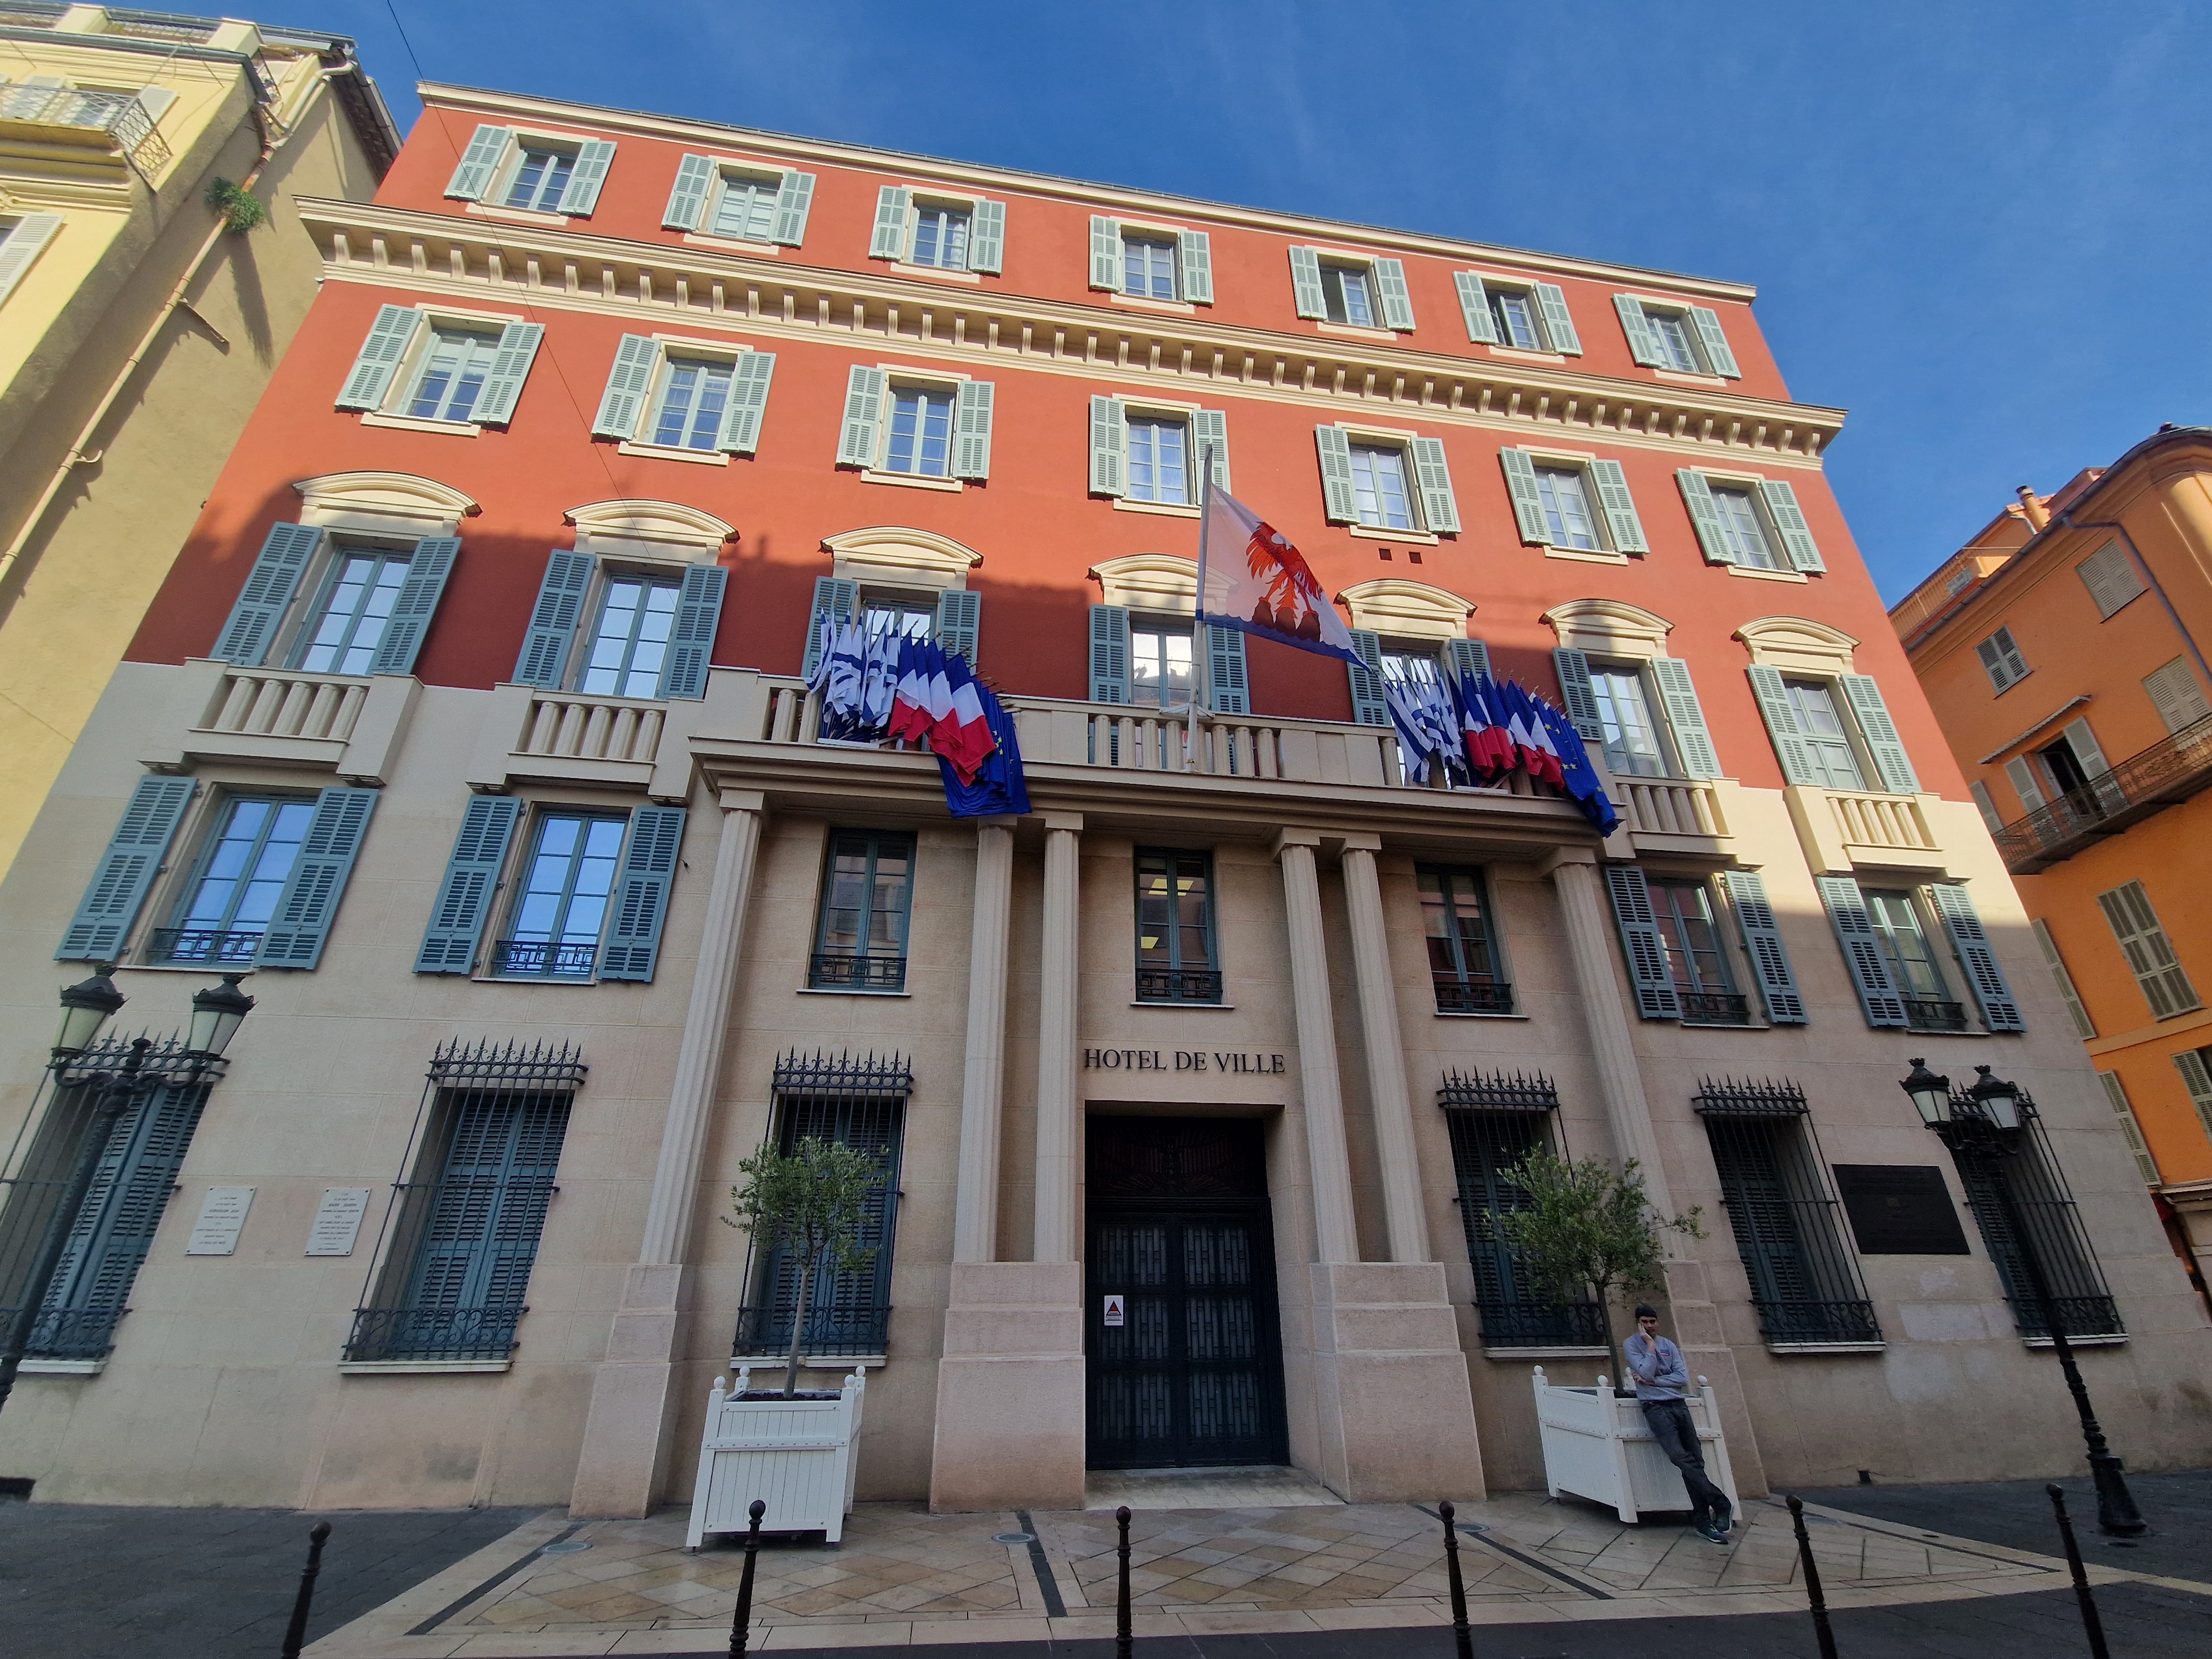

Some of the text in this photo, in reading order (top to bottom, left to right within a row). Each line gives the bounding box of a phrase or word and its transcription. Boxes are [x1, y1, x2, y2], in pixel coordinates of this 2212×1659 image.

[1083, 1048, 1286, 1073] HOTEL DE VILLE
